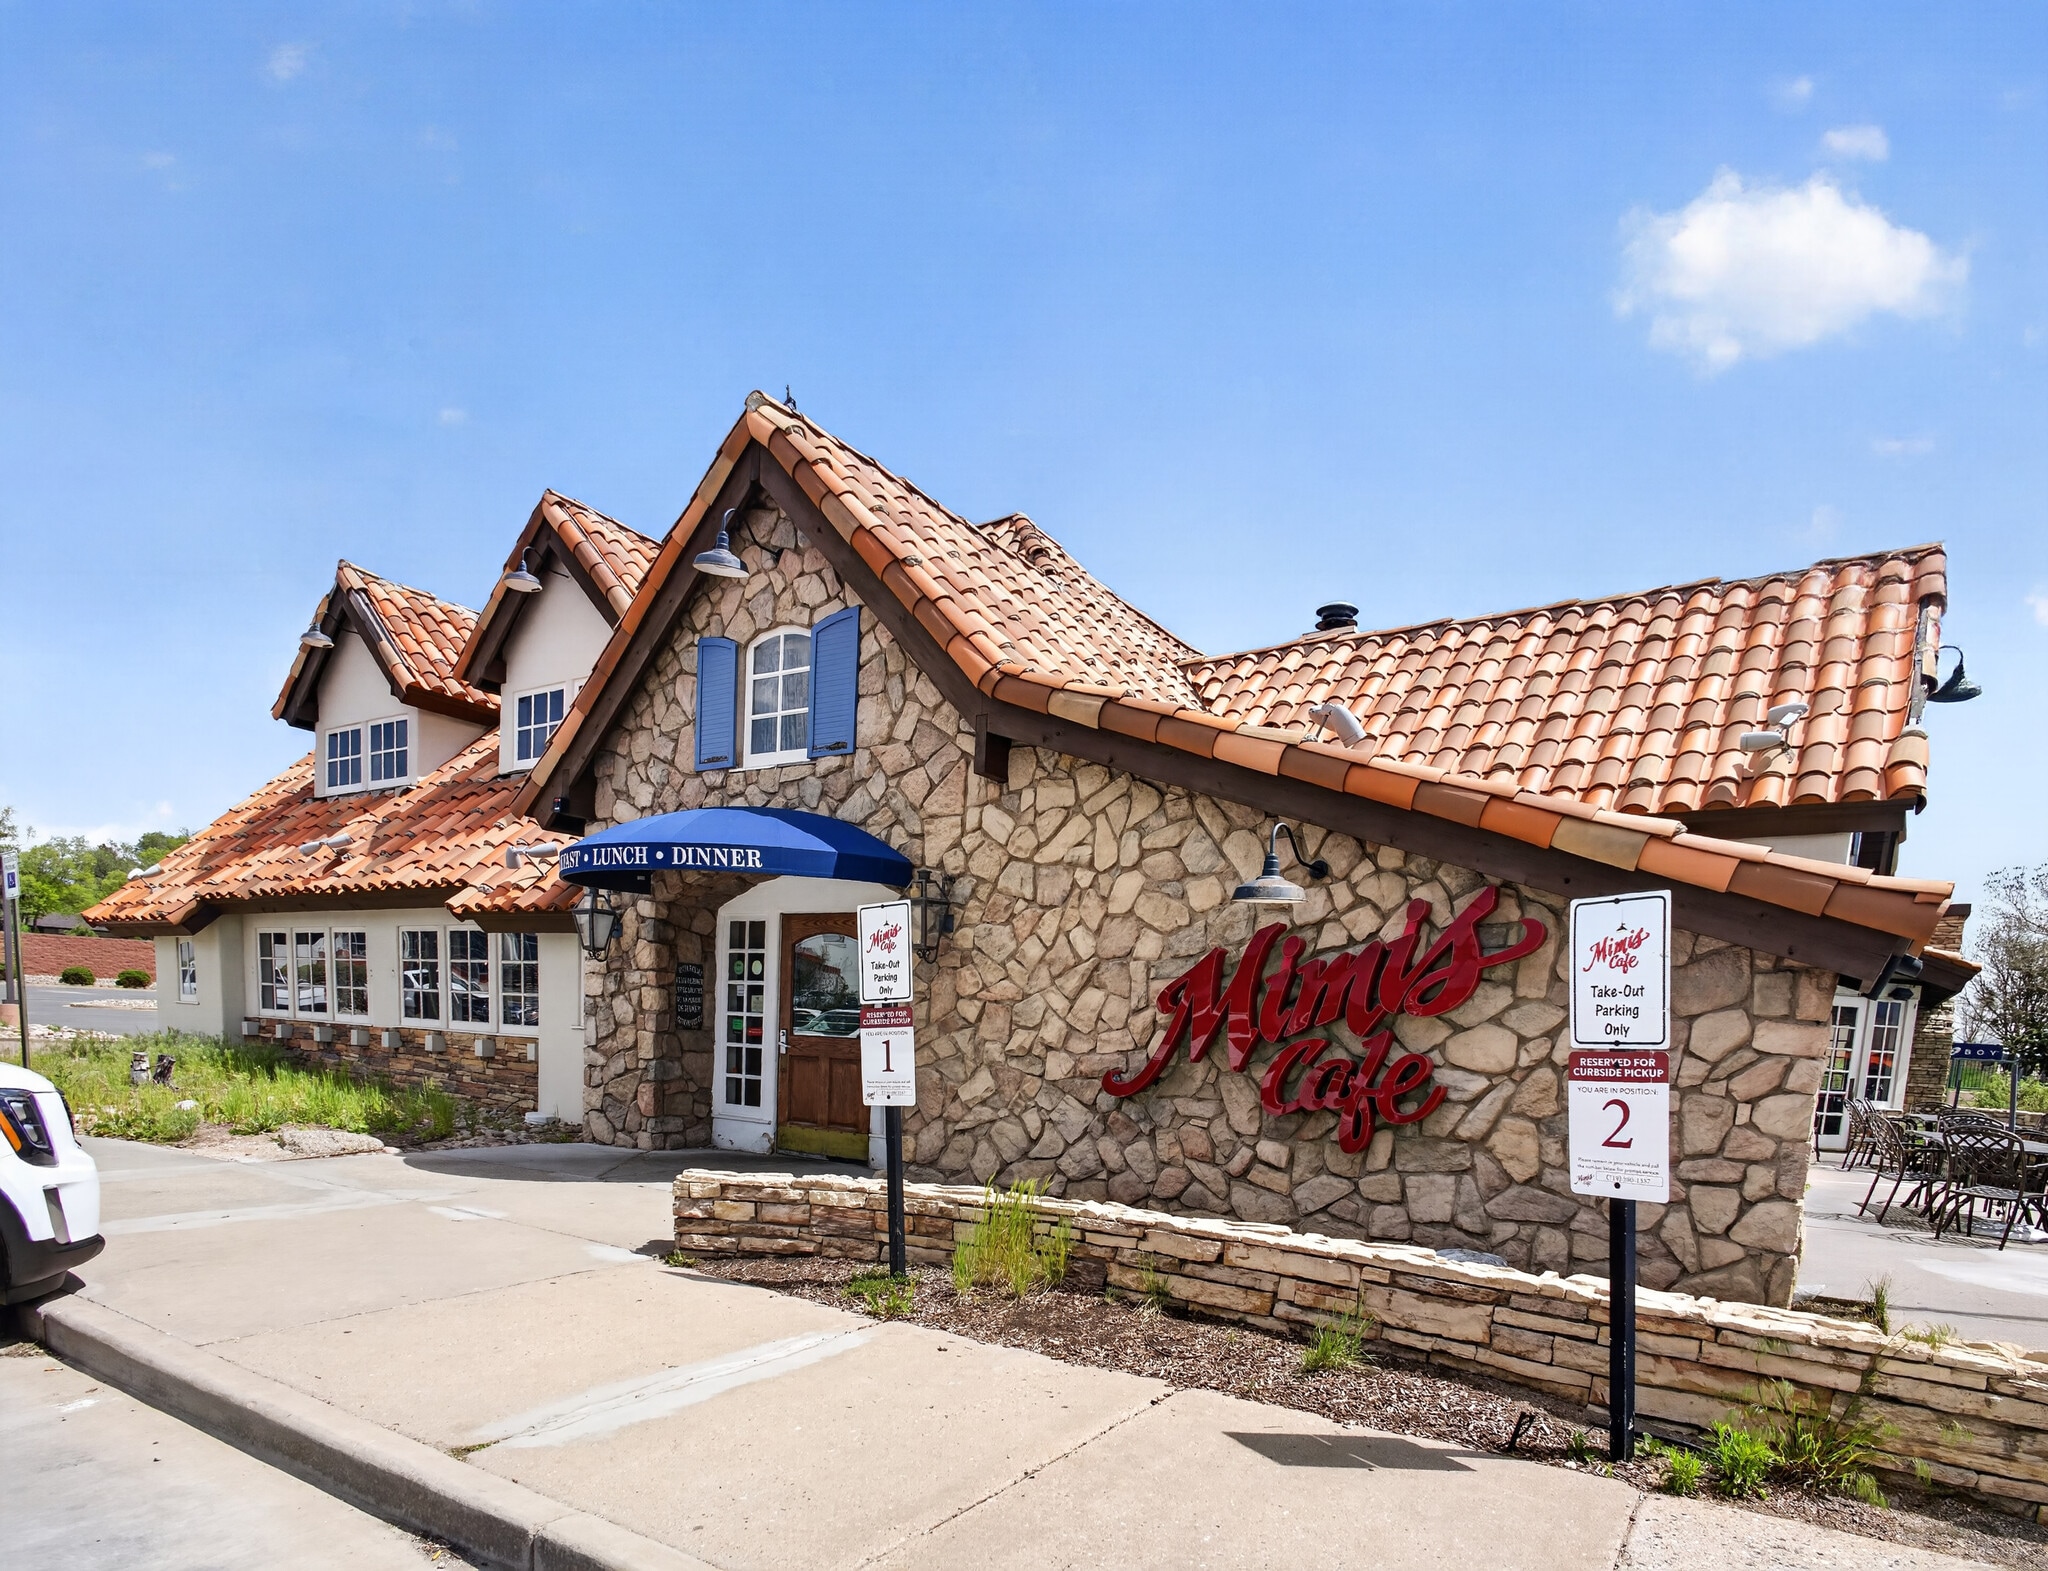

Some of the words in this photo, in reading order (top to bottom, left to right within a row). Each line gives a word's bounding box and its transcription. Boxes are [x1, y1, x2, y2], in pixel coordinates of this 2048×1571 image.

[592, 846, 648, 866] LUNCH
[671, 846, 763, 868] DINNER
[870, 960, 900, 970] Take-Out
[1609, 953, 1639, 974] Cafe
[873, 973, 898, 983] Parking
[879, 986, 893, 995] Only
[1590, 984, 1645, 998] Take-Out
[1595, 1004, 1640, 1019] Parking
[1604, 1023, 1630, 1038] Only
[881, 1039, 895, 1073] 1
[1580, 1057, 1632, 1067] RESERVED
[1633, 1058, 1656, 1067] FOR
[1573, 1067, 1622, 1077] CURBSIDE
[1624, 1069, 1664, 1078] PICKUP
[1261, 1030, 1447, 1154] Cafe
[1601, 1098, 1634, 1149] 2
